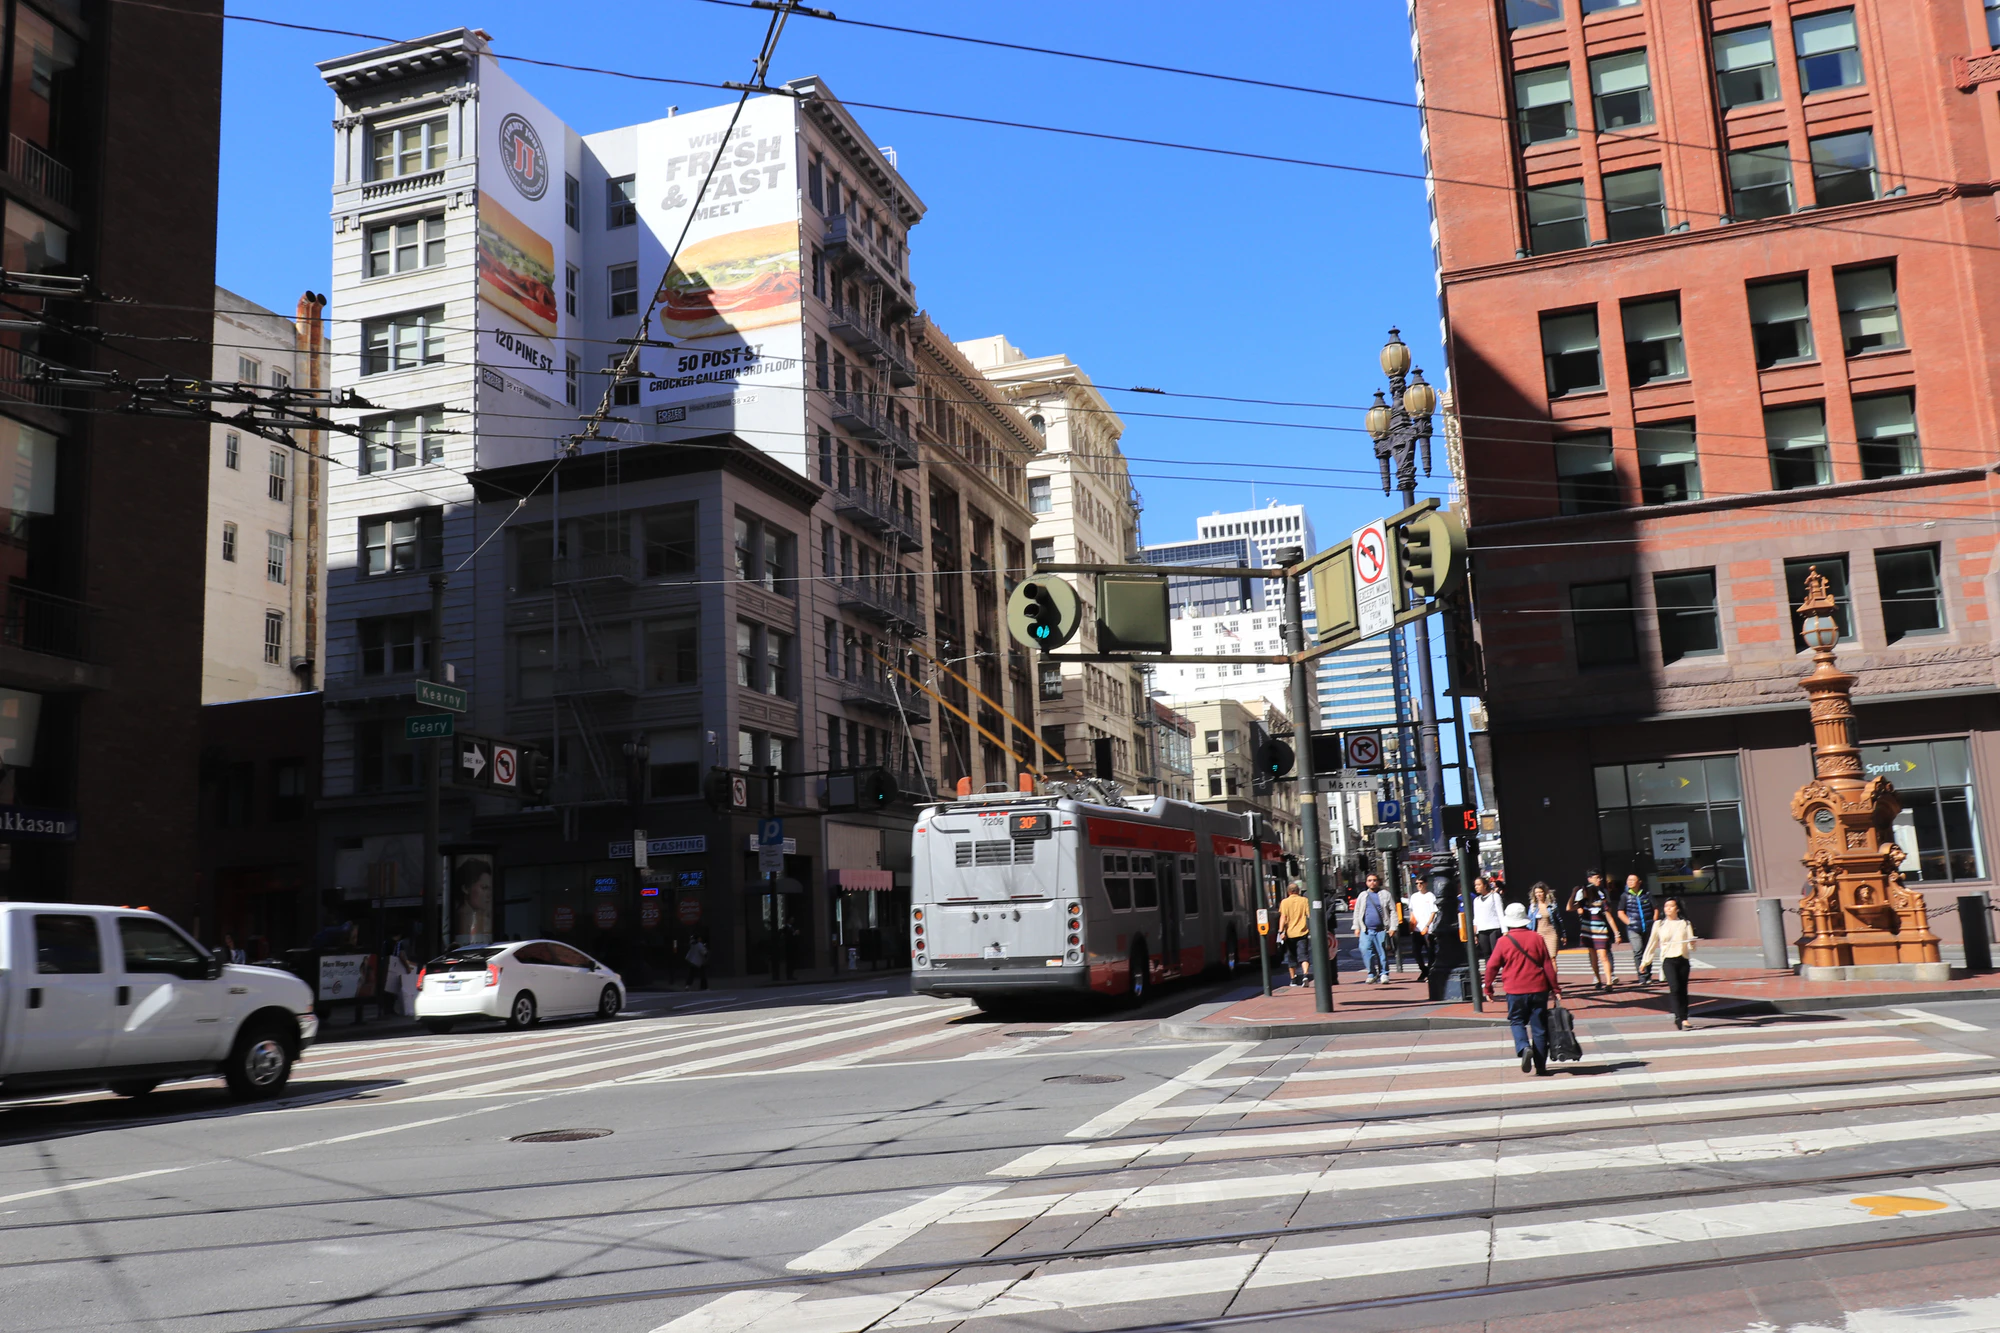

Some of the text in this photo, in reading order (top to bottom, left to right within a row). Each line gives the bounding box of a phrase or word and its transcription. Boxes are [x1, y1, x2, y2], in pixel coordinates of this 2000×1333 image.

[504, 121, 545, 166] JIMMY JOHN'S
[688, 124, 752, 149] WHERE
[513, 134, 535, 180] JJ
[666, 135, 782, 182] FRESH
[661, 162, 786, 211] & FAST
[495, 328, 554, 375] 120 PINE ST.
[677, 354, 699, 373] 50
[701, 346, 742, 369] POST
[649, 359, 796, 392] CROCKER GALLERIA 3RD FLOOR
[658, 408, 684, 418] FOSTER
[422, 686, 461, 708] Kearny
[411, 721, 447, 734] Geary
[464, 756, 484, 765] ONE WAY
[1865, 761, 1901, 776] Sprint
[1328, 780, 1368, 790] Market
[0, 811, 66, 834] kkasan
[982, 817, 1004, 827] 7209
[1463, 809, 1477, 831] 15
[652, 839, 704, 851] CASHING
